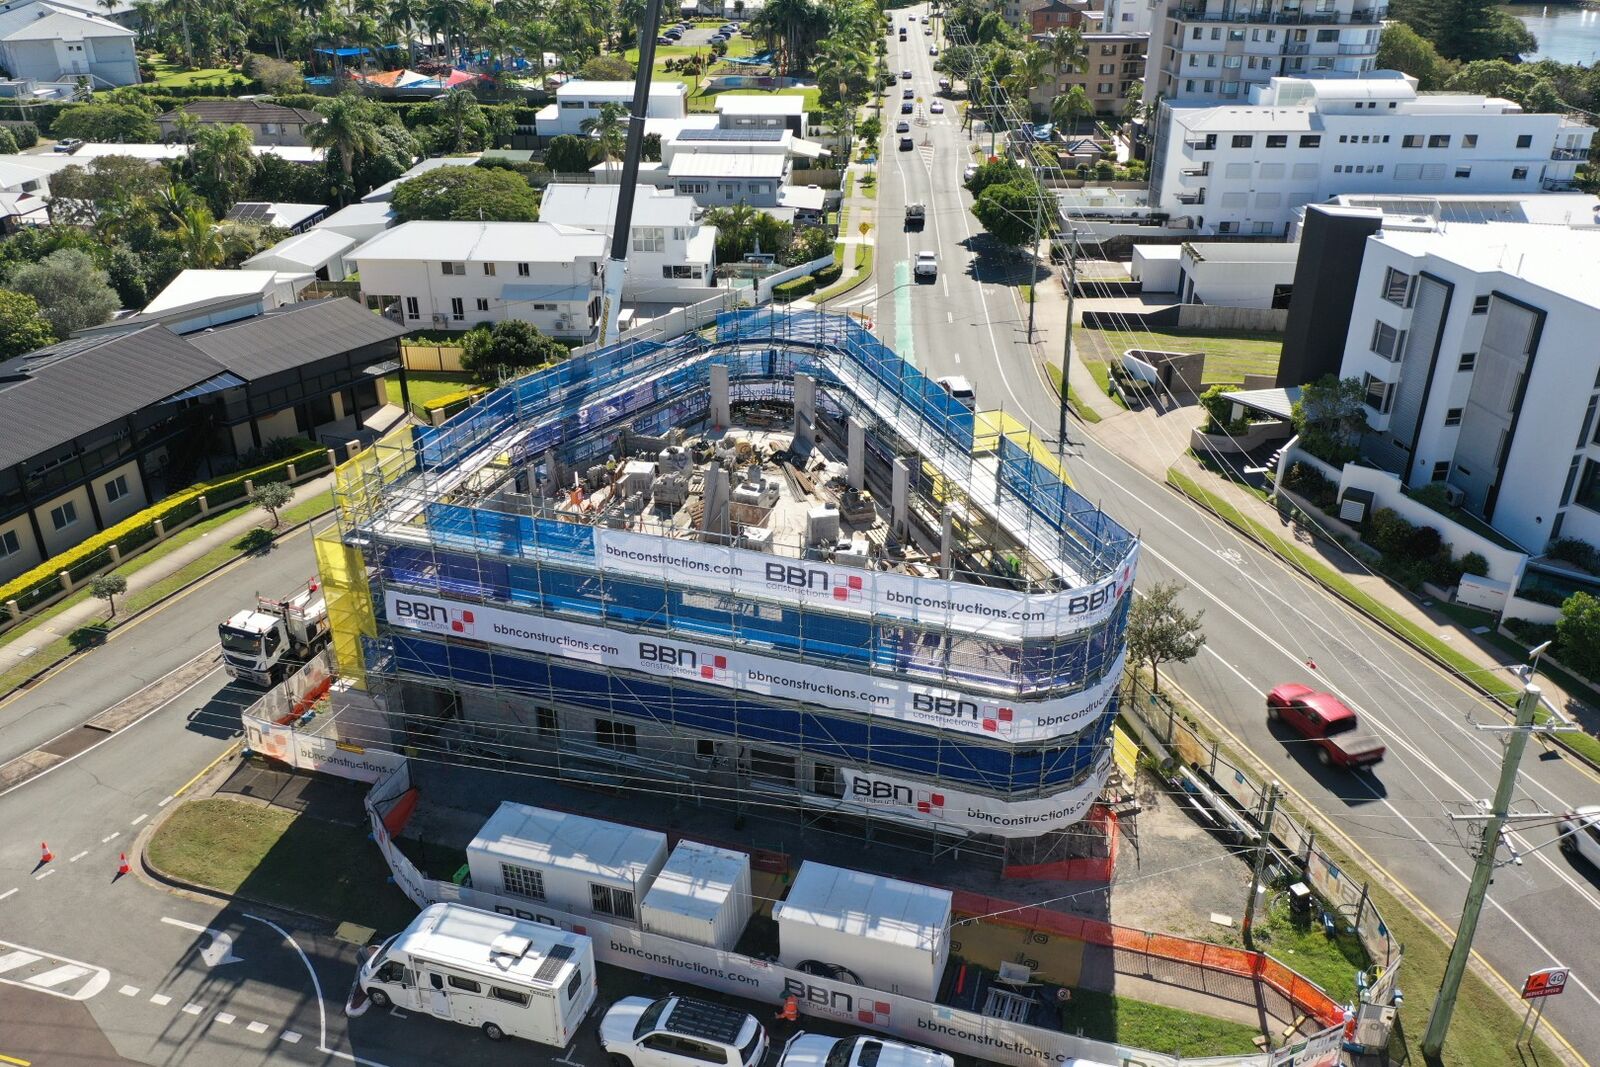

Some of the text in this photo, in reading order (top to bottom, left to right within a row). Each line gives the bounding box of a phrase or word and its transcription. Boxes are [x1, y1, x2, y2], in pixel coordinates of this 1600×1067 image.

[605, 544, 743, 577] bbnconstructions.com
[765, 562, 829, 592] BBN
[765, 581, 831, 600] constructions
[395, 599, 448, 624] BBN
[886, 589, 1045, 622] bbnconstructions.com
[493, 623, 619, 656] bbnconstructions.com
[639, 641, 697, 669] BBN
[639, 659, 698, 677] constructions
[747, 669, 890, 706] bbnconstructions.com
[300, 748, 395, 775] bbnconstructions.c
[852, 776, 913, 804] BBN
[967, 790, 1093, 826] bbnconstructions.com
[610, 940, 760, 987] bbnconstructions.com
[917, 1017, 1075, 1062] bbnconstructions.c
